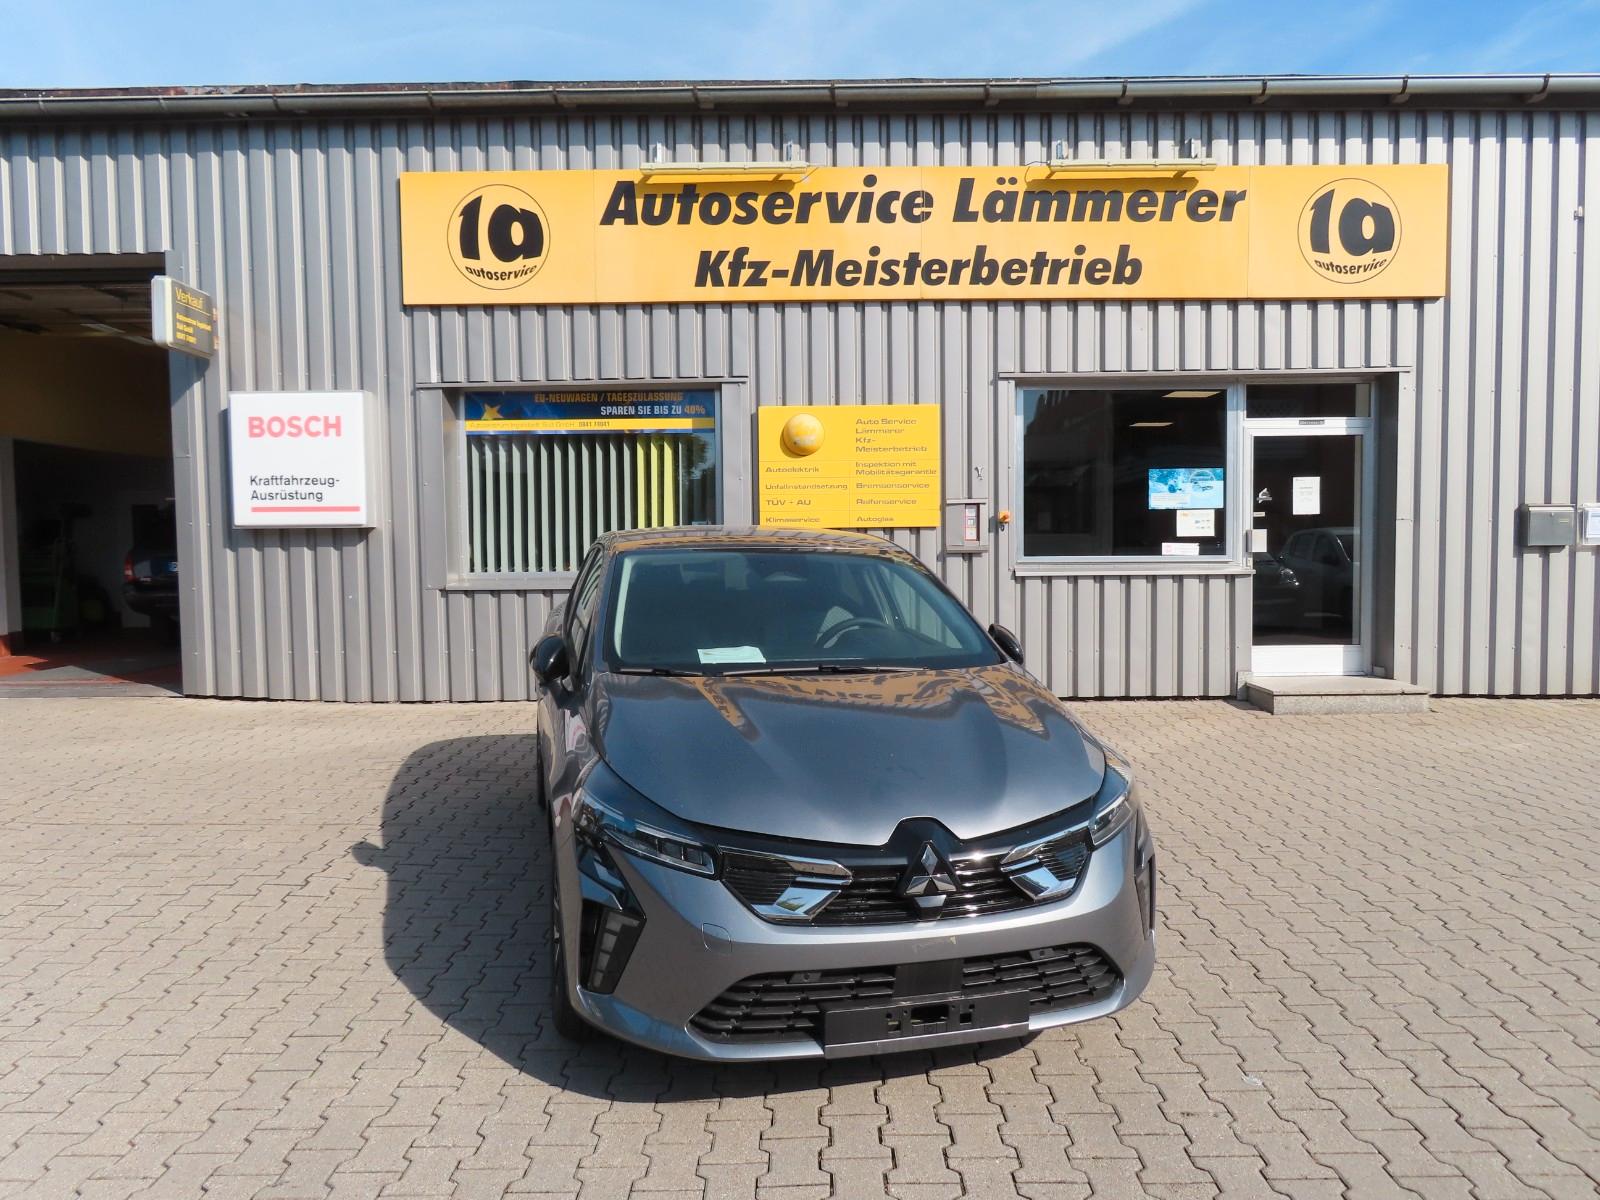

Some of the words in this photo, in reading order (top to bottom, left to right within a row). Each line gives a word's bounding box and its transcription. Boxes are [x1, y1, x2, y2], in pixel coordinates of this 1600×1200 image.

[599, 174, 933, 226] Autoservice
[952, 177, 1247, 223] Lämmerer
[1310, 188, 1395, 256] 1a
[459, 195, 543, 262] 1a
[694, 245, 1143, 287] Kfz-Meisterbetrieb
[1315, 259, 1386, 274] autoservice
[465, 265, 537, 280] autoservice
[534, 392, 598, 402] EU-NEUWAGEN
[606, 391, 685, 402] TAGESZULASSUNG
[600, 406, 635, 415] SPAREN
[637, 405, 652, 415] SIE
[654, 405, 669, 414] BIS
[670, 405, 682, 414] ZU
[248, 415, 341, 438] BOSCH
[856, 461, 901, 469] Inspektion
[250, 475, 340, 487] Kraftfahrzeug-
[765, 483, 848, 491] Unfallinstandsetzung
[251, 490, 323, 502] Ausrüstung
[766, 497, 786, 505] TÜV
[856, 515, 894, 523] Autoglas
